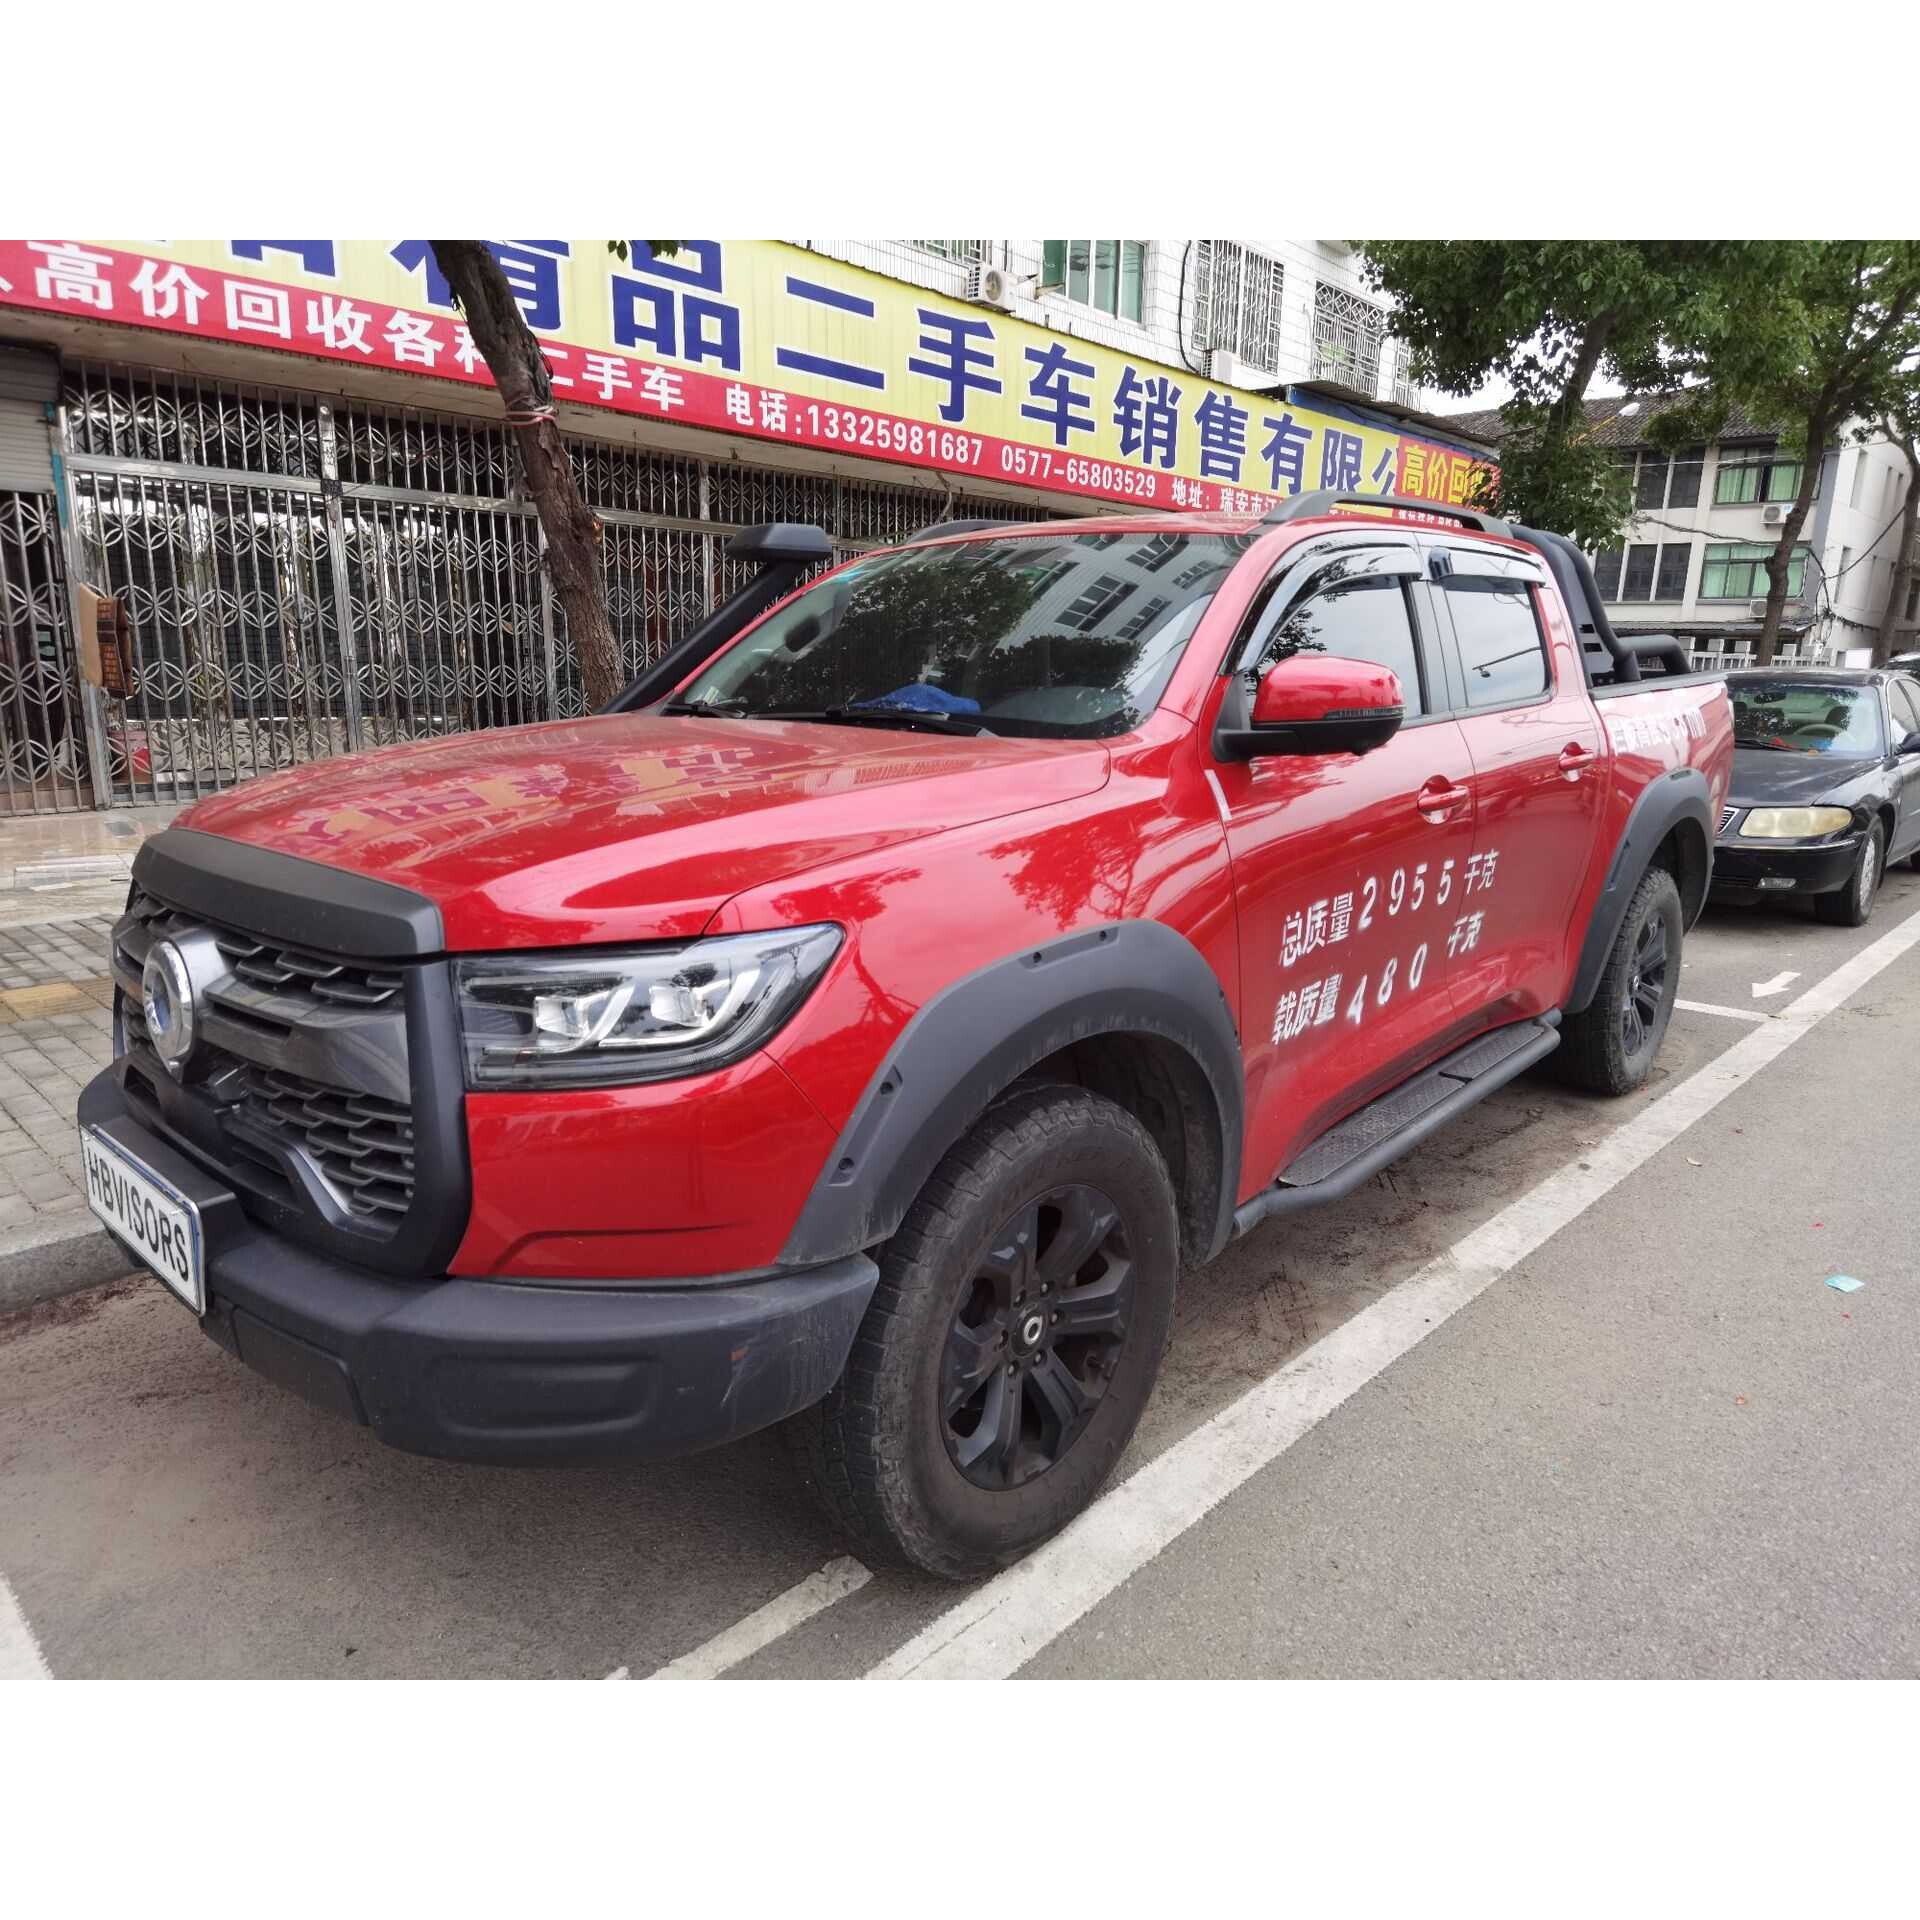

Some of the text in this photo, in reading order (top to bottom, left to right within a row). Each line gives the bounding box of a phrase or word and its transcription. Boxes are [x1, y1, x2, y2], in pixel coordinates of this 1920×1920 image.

[0, 240, 684, 412] 高价回收各二手车
[1001, 444, 1156, 498] 0577-65803529
[232, 240, 1398, 498] 品二手车销售有限
[87, 1148, 189, 1281] HBVISORS
